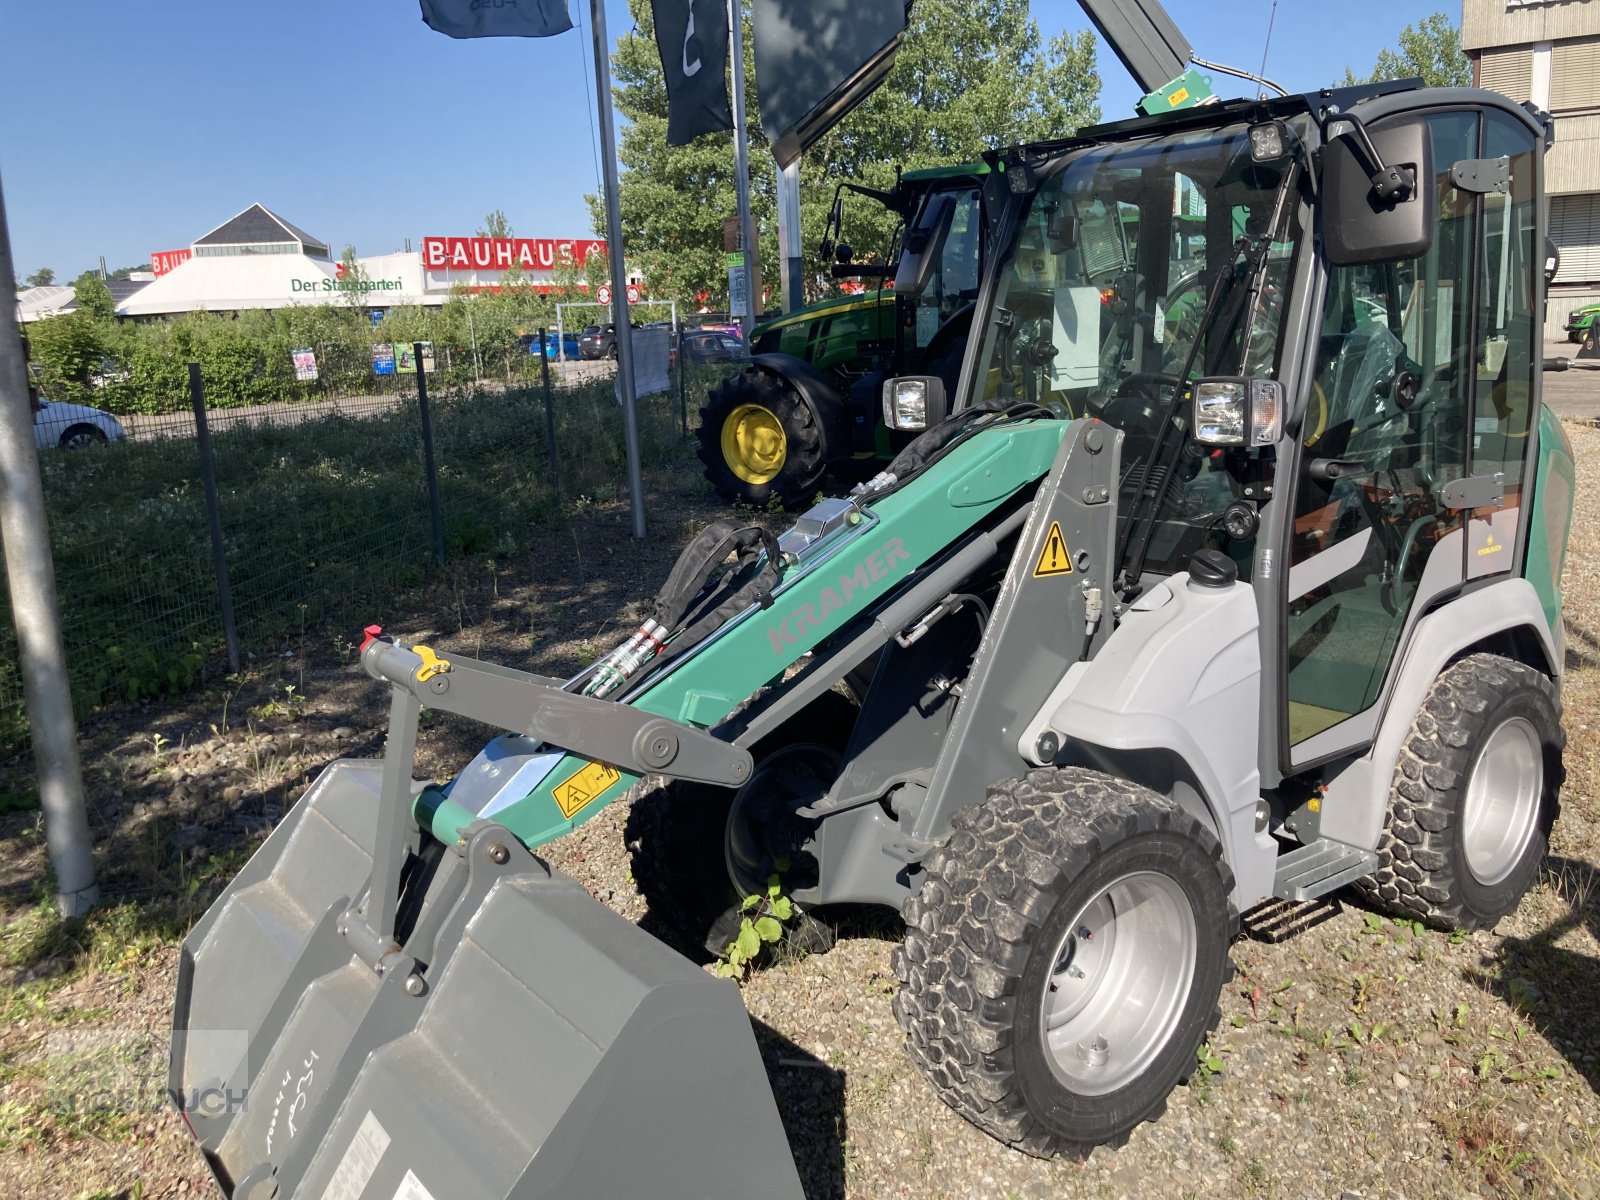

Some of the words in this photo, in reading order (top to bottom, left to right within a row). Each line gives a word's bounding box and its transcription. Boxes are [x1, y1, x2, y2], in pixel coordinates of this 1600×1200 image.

[429, 241, 573, 266] BAUHAUS
[291, 278, 317, 292] Der
[322, 278, 403, 294] Stagarten
[767, 537, 910, 655] KRAMER
